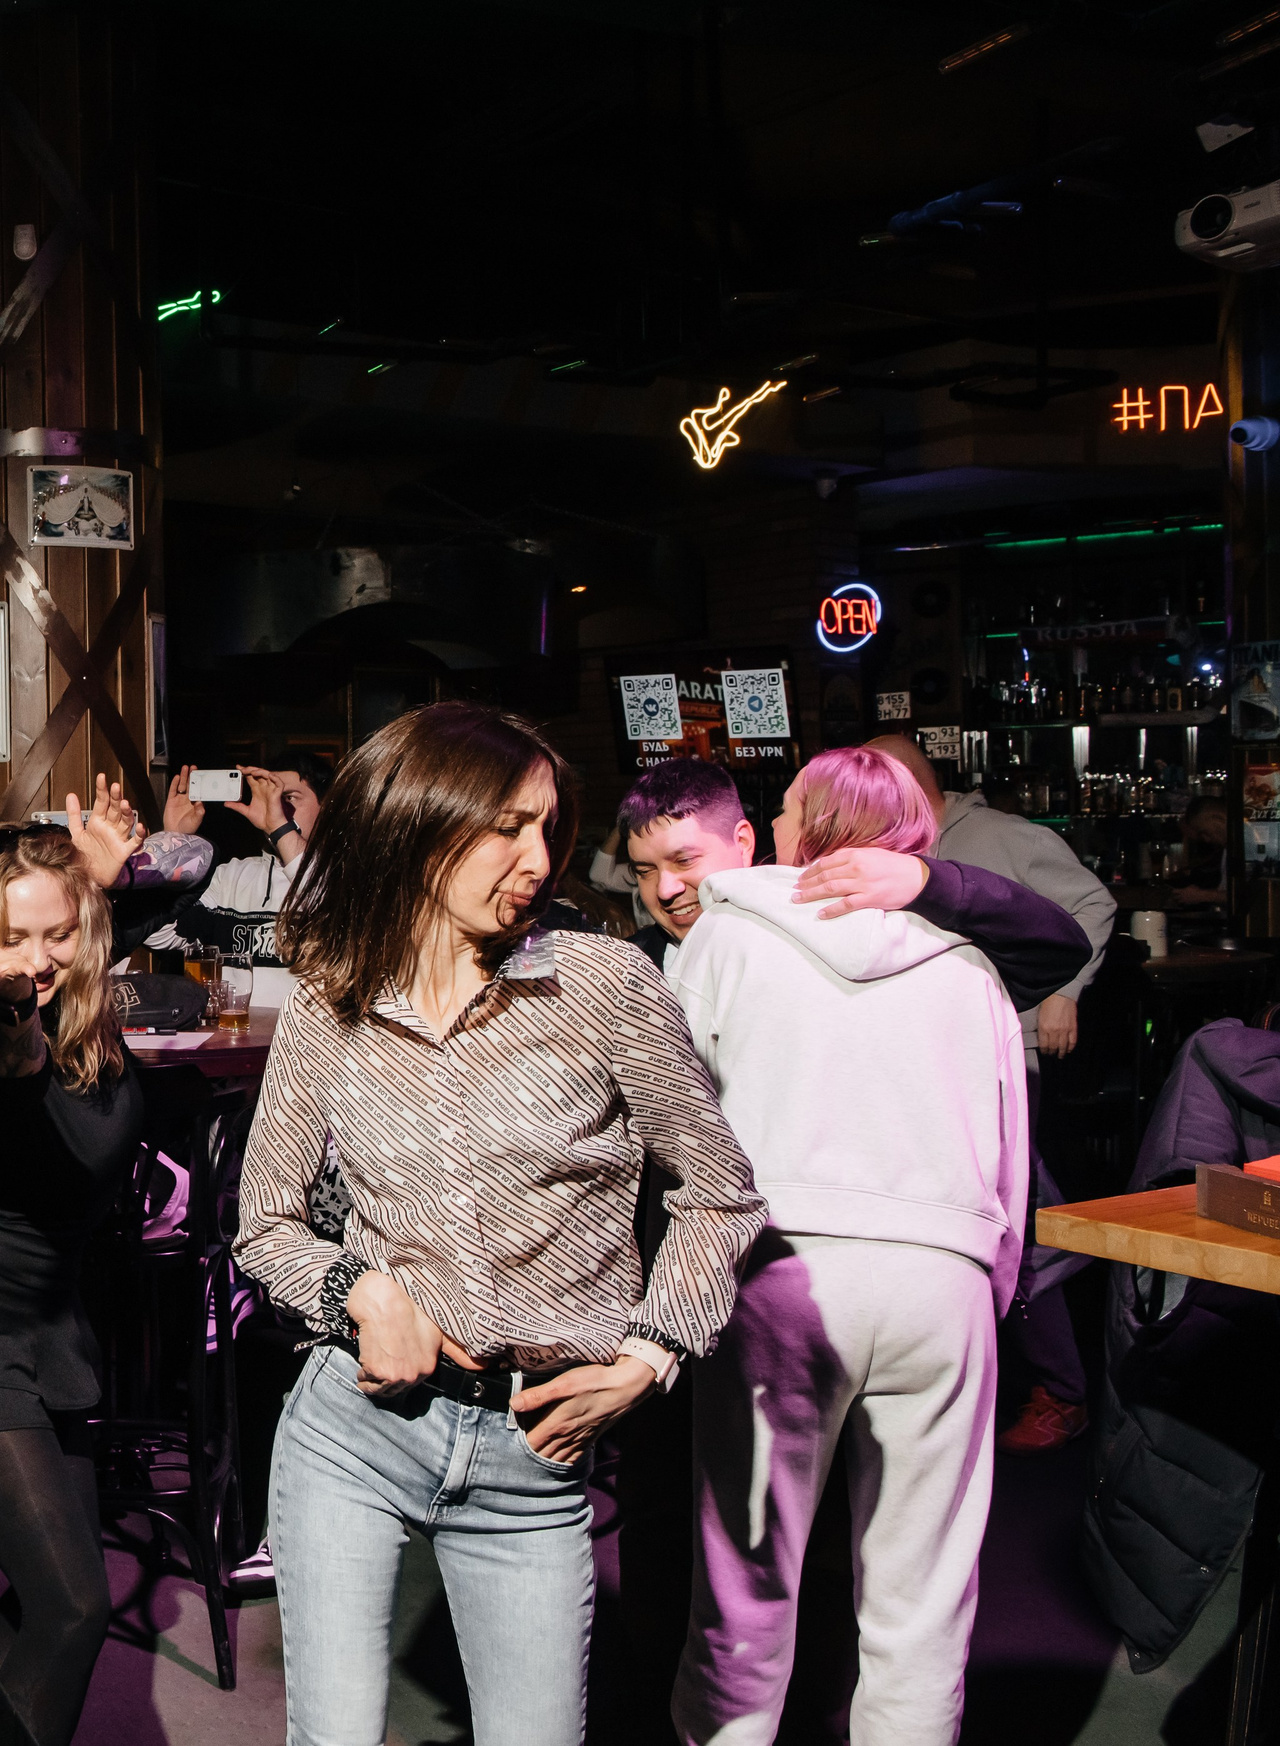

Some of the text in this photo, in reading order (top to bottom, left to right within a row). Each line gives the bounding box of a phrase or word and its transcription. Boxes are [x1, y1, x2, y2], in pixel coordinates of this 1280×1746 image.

[820, 597, 878, 635] OPEN
[895, 708, 908, 717] 77
[642, 741, 670, 752] БУДЬ
[735, 746, 784, 757] БЕЗ VPN
[937, 744, 957, 755] 193
[636, 757, 644, 767] С
[561, 957, 618, 1000] GUESS LOS ANGELES
[591, 952, 625, 979] GUESS LOS
[563, 980, 580, 999] GUESS
[580, 994, 592, 1006] LOS
[556, 1003, 568, 1016] LOS
[567, 1013, 585, 1031] GUESS
[624, 1002, 651, 1019] ANGELES
[299, 1018, 347, 1060] GUESS LOS ANGELES
[530, 1012, 582, 1057] GUESS LOS ANGELES
[281, 1036, 312, 1089] GUESS LOS ANGELES
[306, 1044, 350, 1087] GUESS LOS ANGELES
[380, 1038, 428, 1079] GUESS LOS ANGELES
[466, 1041, 520, 1093] GUESS LOS ANGELES
[497, 1040, 551, 1089] GUESS LOS ANGELES
[648, 1056, 686, 1073] GUESS LOS
[357, 1068, 404, 1113] GUESS LOS ANGELES
[380, 1065, 429, 1107] GUESS LOS ANGELES
[562, 1068, 583, 1090] ANGELES
[621, 1067, 691, 1093] GUESS LOS ANGELES
[460, 1090, 490, 1119] GUESS LOS
[465, 1069, 519, 1121] GUESS LOS ANGELES
[559, 1097, 574, 1114] GUESS
[631, 1089, 702, 1116] GUESS LOS ANGELES
[339, 1099, 382, 1144] GUESS LOS ANGELES
[358, 1095, 406, 1140] GUESS LOS ANGELES
[261, 1117, 300, 1170] GUESS LOS ANGELES
[284, 1122, 300, 1138] GUESS
[304, 1146, 319, 1169] ANGELES
[465, 1125, 493, 1148] ANGELES
[533, 1128, 555, 1143] GUESS
[554, 1141, 567, 1152] LOS
[650, 1126, 681, 1138] ANGELES
[340, 1126, 387, 1174] GUESS LOS ANGELES
[393, 1155, 432, 1183] LOS ANGELES
[476, 1158, 528, 1197] GUESS LOS ANGELES
[525, 1165, 537, 1175] LOS
[696, 1165, 708, 1177] LOS
[707, 1173, 727, 1190] GUESS
[480, 1187, 534, 1226] GUESS LOS ANGELES
[431, 1237, 458, 1261] ANGELES
[558, 1237, 569, 1250] LOS
[547, 1257, 566, 1273] GUESS
[514, 1289, 525, 1297] LOS
[531, 1273, 544, 1284] LOS
[543, 1281, 565, 1299] ANGELES
[436, 1283, 453, 1303] GUESS
[451, 1301, 462, 1318] LOS
[524, 1293, 542, 1309] GUESS
[677, 1279, 701, 1342] GUESS LOS ANGELES
[704, 1293, 718, 1327] GUESS LOS
[574, 1303, 627, 1331] GUESS LOS ANGELES
